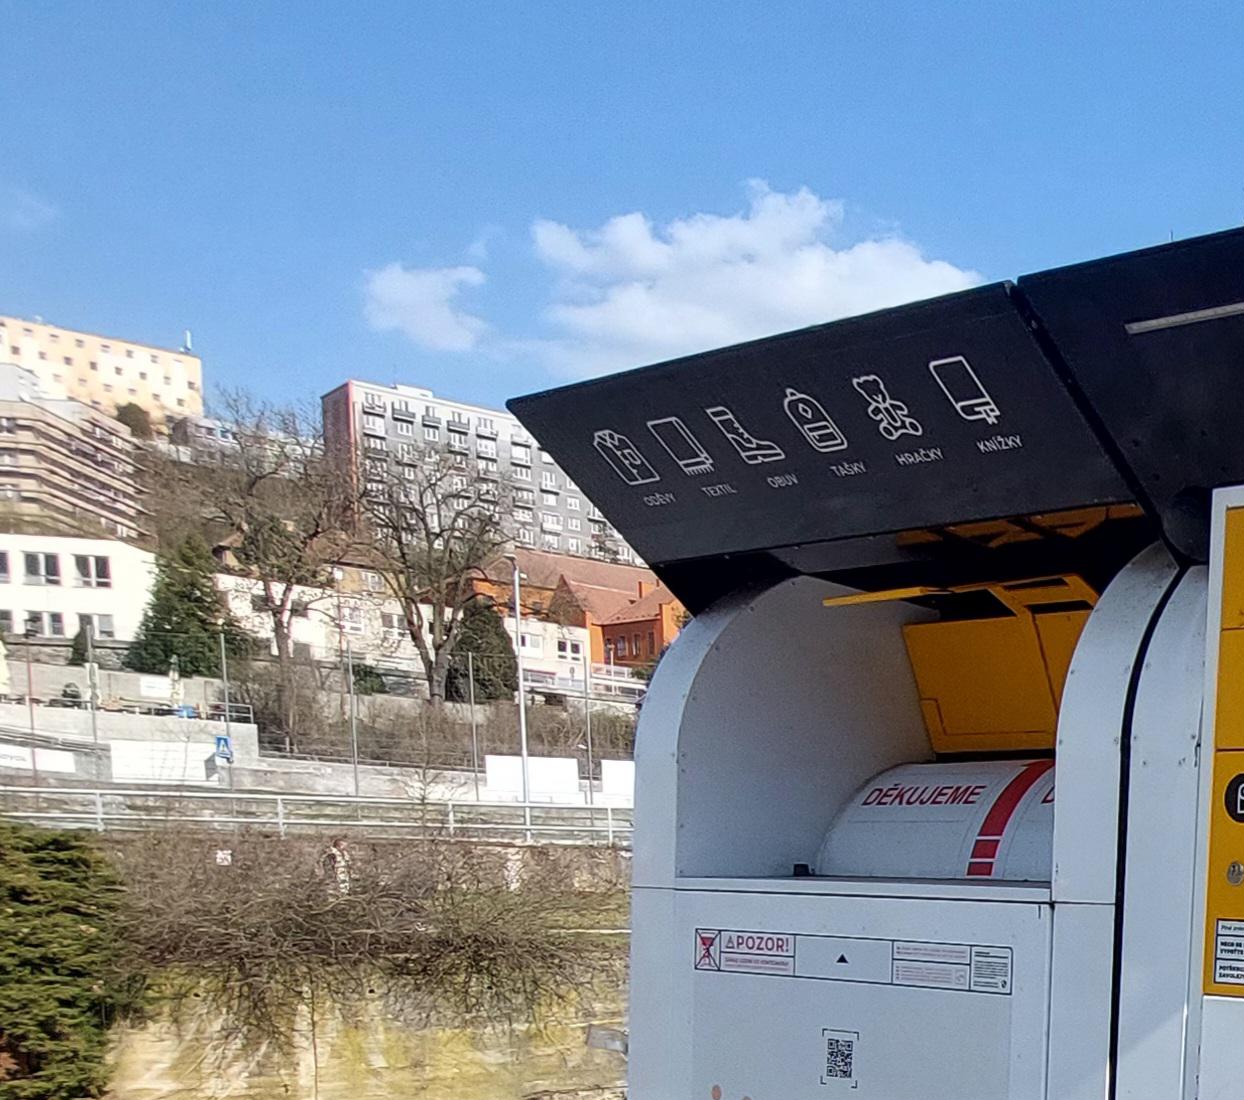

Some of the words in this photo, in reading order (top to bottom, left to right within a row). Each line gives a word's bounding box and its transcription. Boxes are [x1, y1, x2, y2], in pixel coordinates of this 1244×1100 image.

[977, 435, 1023, 454] KNÍŽKY
[895, 447, 944, 467] HRAČKY
[830, 460, 867, 478] TAŠKY
[767, 473, 799, 489] OBUV
[701, 484, 737, 498] TEXTIL
[861, 783, 987, 806] DĚKUJEME
[736, 935, 789, 953] POZOR!
